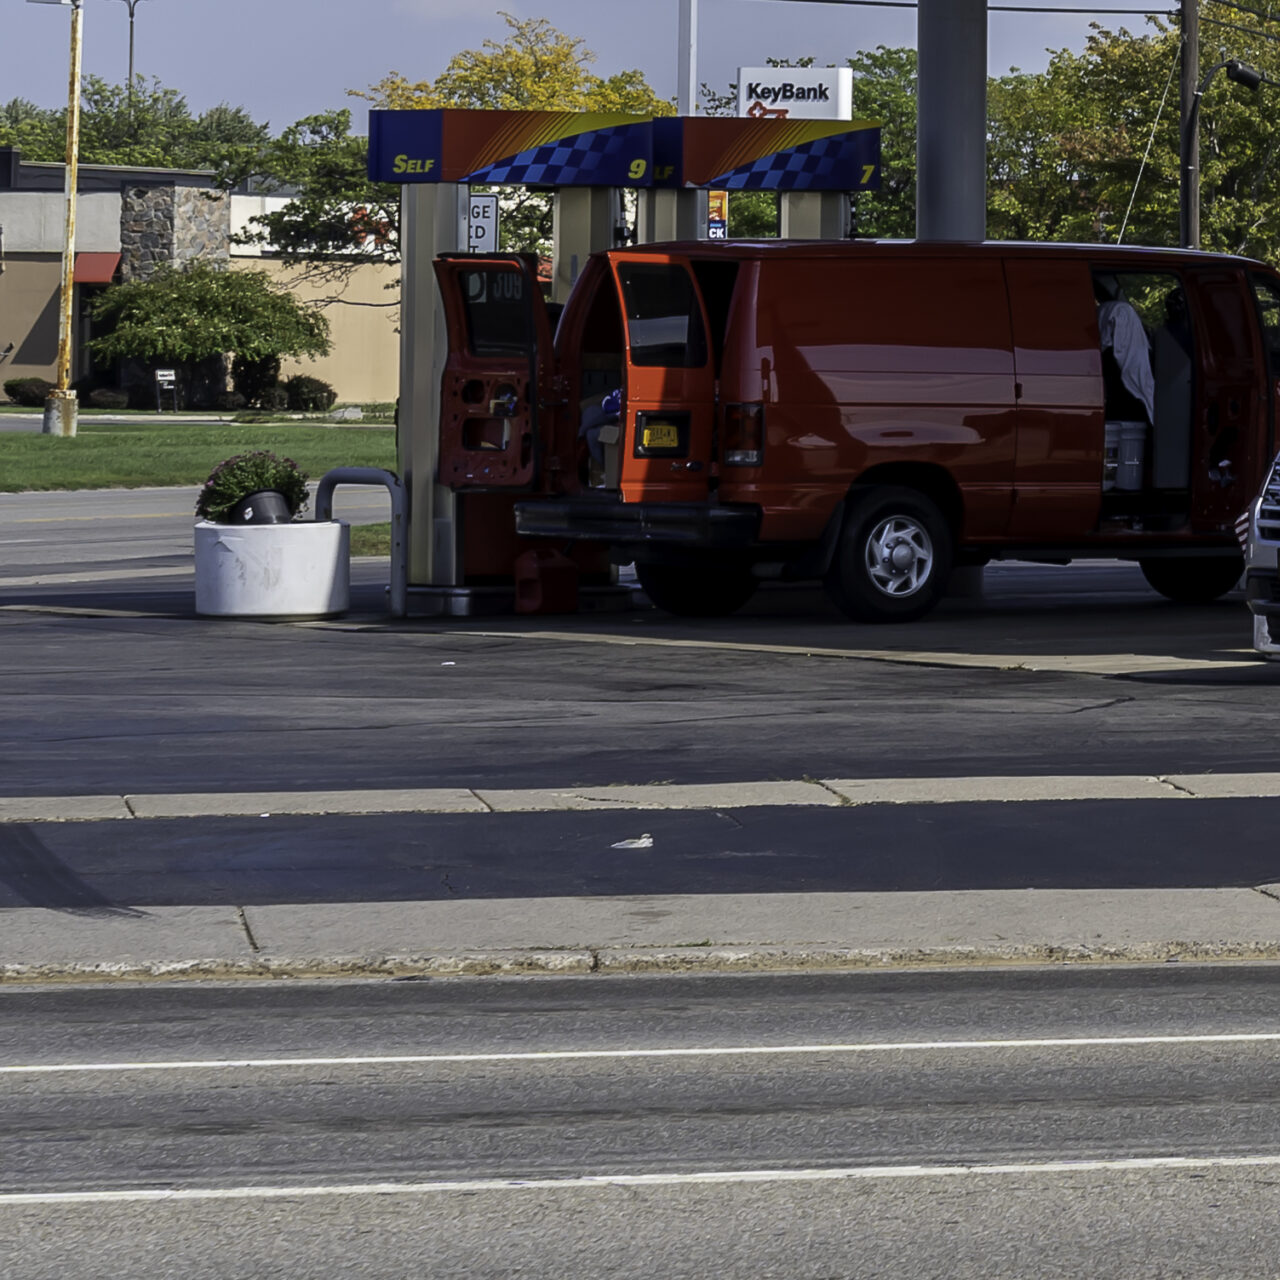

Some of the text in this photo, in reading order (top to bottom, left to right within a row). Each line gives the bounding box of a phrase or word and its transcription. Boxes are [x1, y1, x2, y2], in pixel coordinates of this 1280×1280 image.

[746, 82, 830, 105] KeyBank
[628, 159, 647, 180] 9
[860, 165, 875, 184] 7
